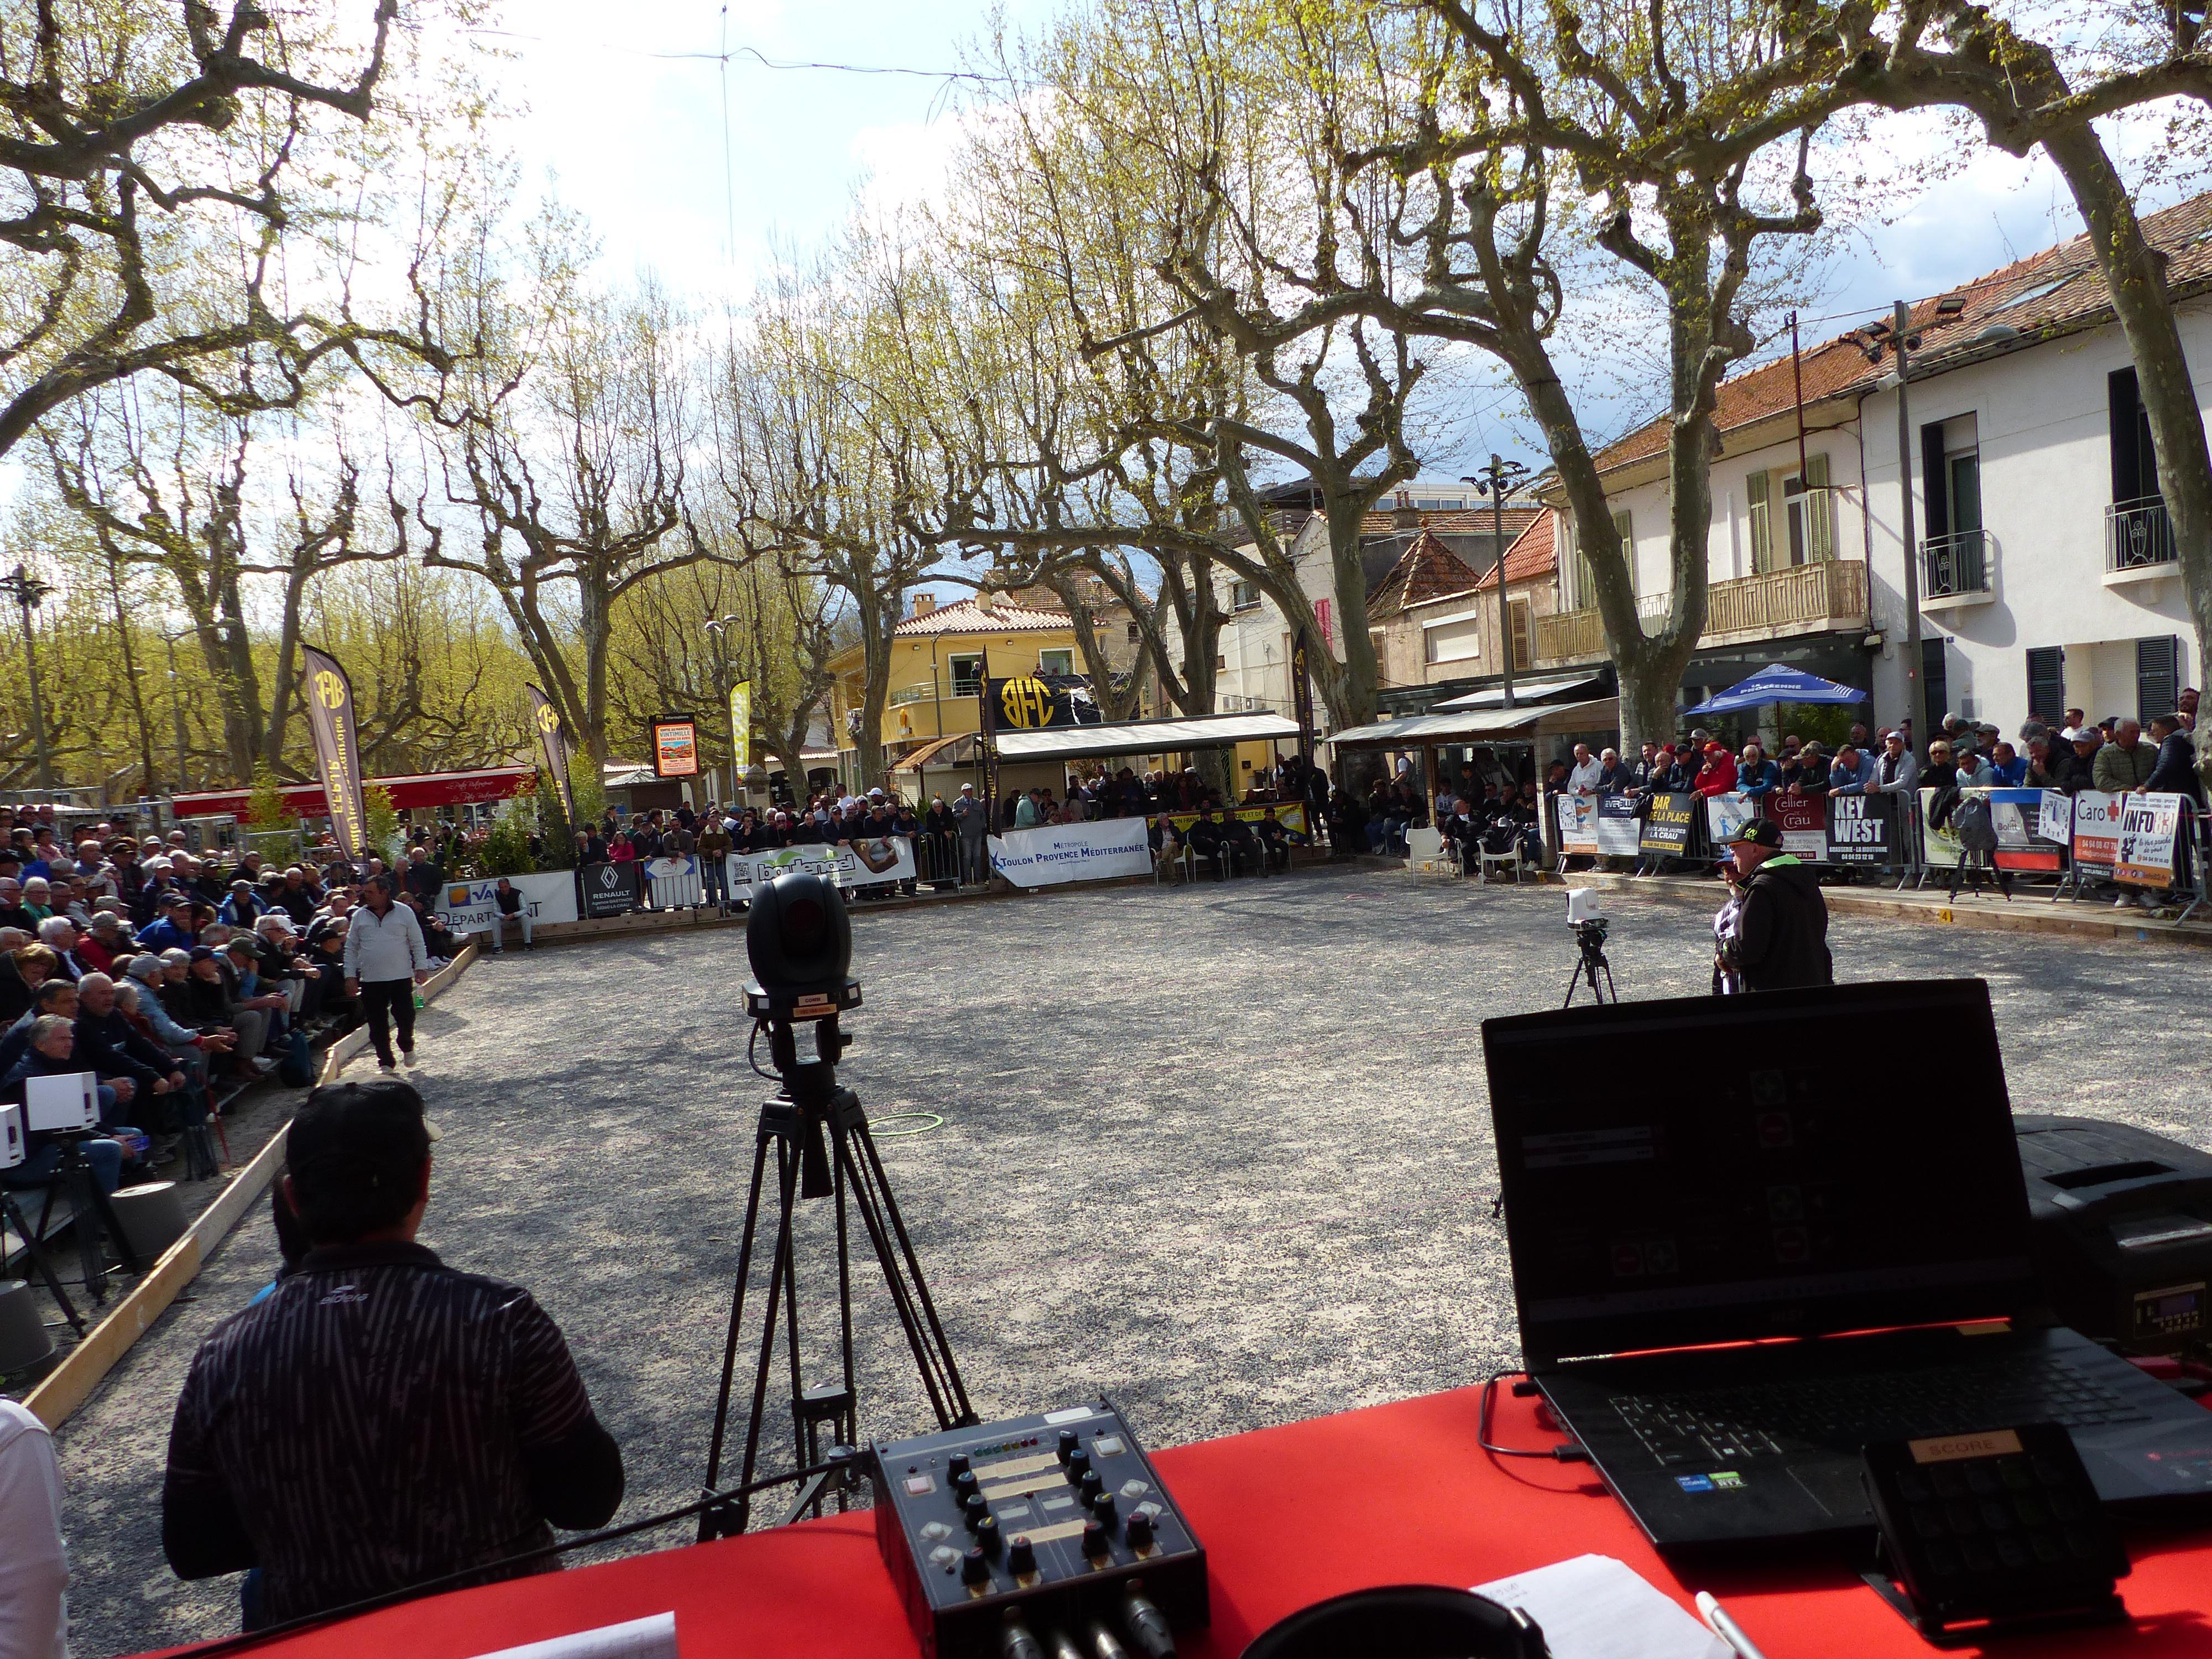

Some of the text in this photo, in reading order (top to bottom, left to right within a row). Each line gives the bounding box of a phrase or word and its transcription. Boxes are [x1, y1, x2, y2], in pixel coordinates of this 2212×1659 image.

[1001, 677, 1054, 728] BFC
[1652, 796, 1671, 810] BAR
[1775, 795, 1808, 812] Cellier
[1835, 796, 1866, 819] KEY
[2078, 799, 2105, 821] Caro
[1648, 811, 1690, 823] DE LA PLACE
[1783, 813, 1811, 829] Crau
[1834, 819, 1884, 842] WEST
[1053, 841, 1088, 849] MÉTROPOLE
[2154, 836, 2171, 847] proche
[1000, 844, 1145, 867] TOULON PROVENCE MÉDITERRANÉE
[593, 890, 630, 900] RENAULT
[1942, 911, 1947, 921] 4
[1929, 1439, 1996, 1456] SCORE
